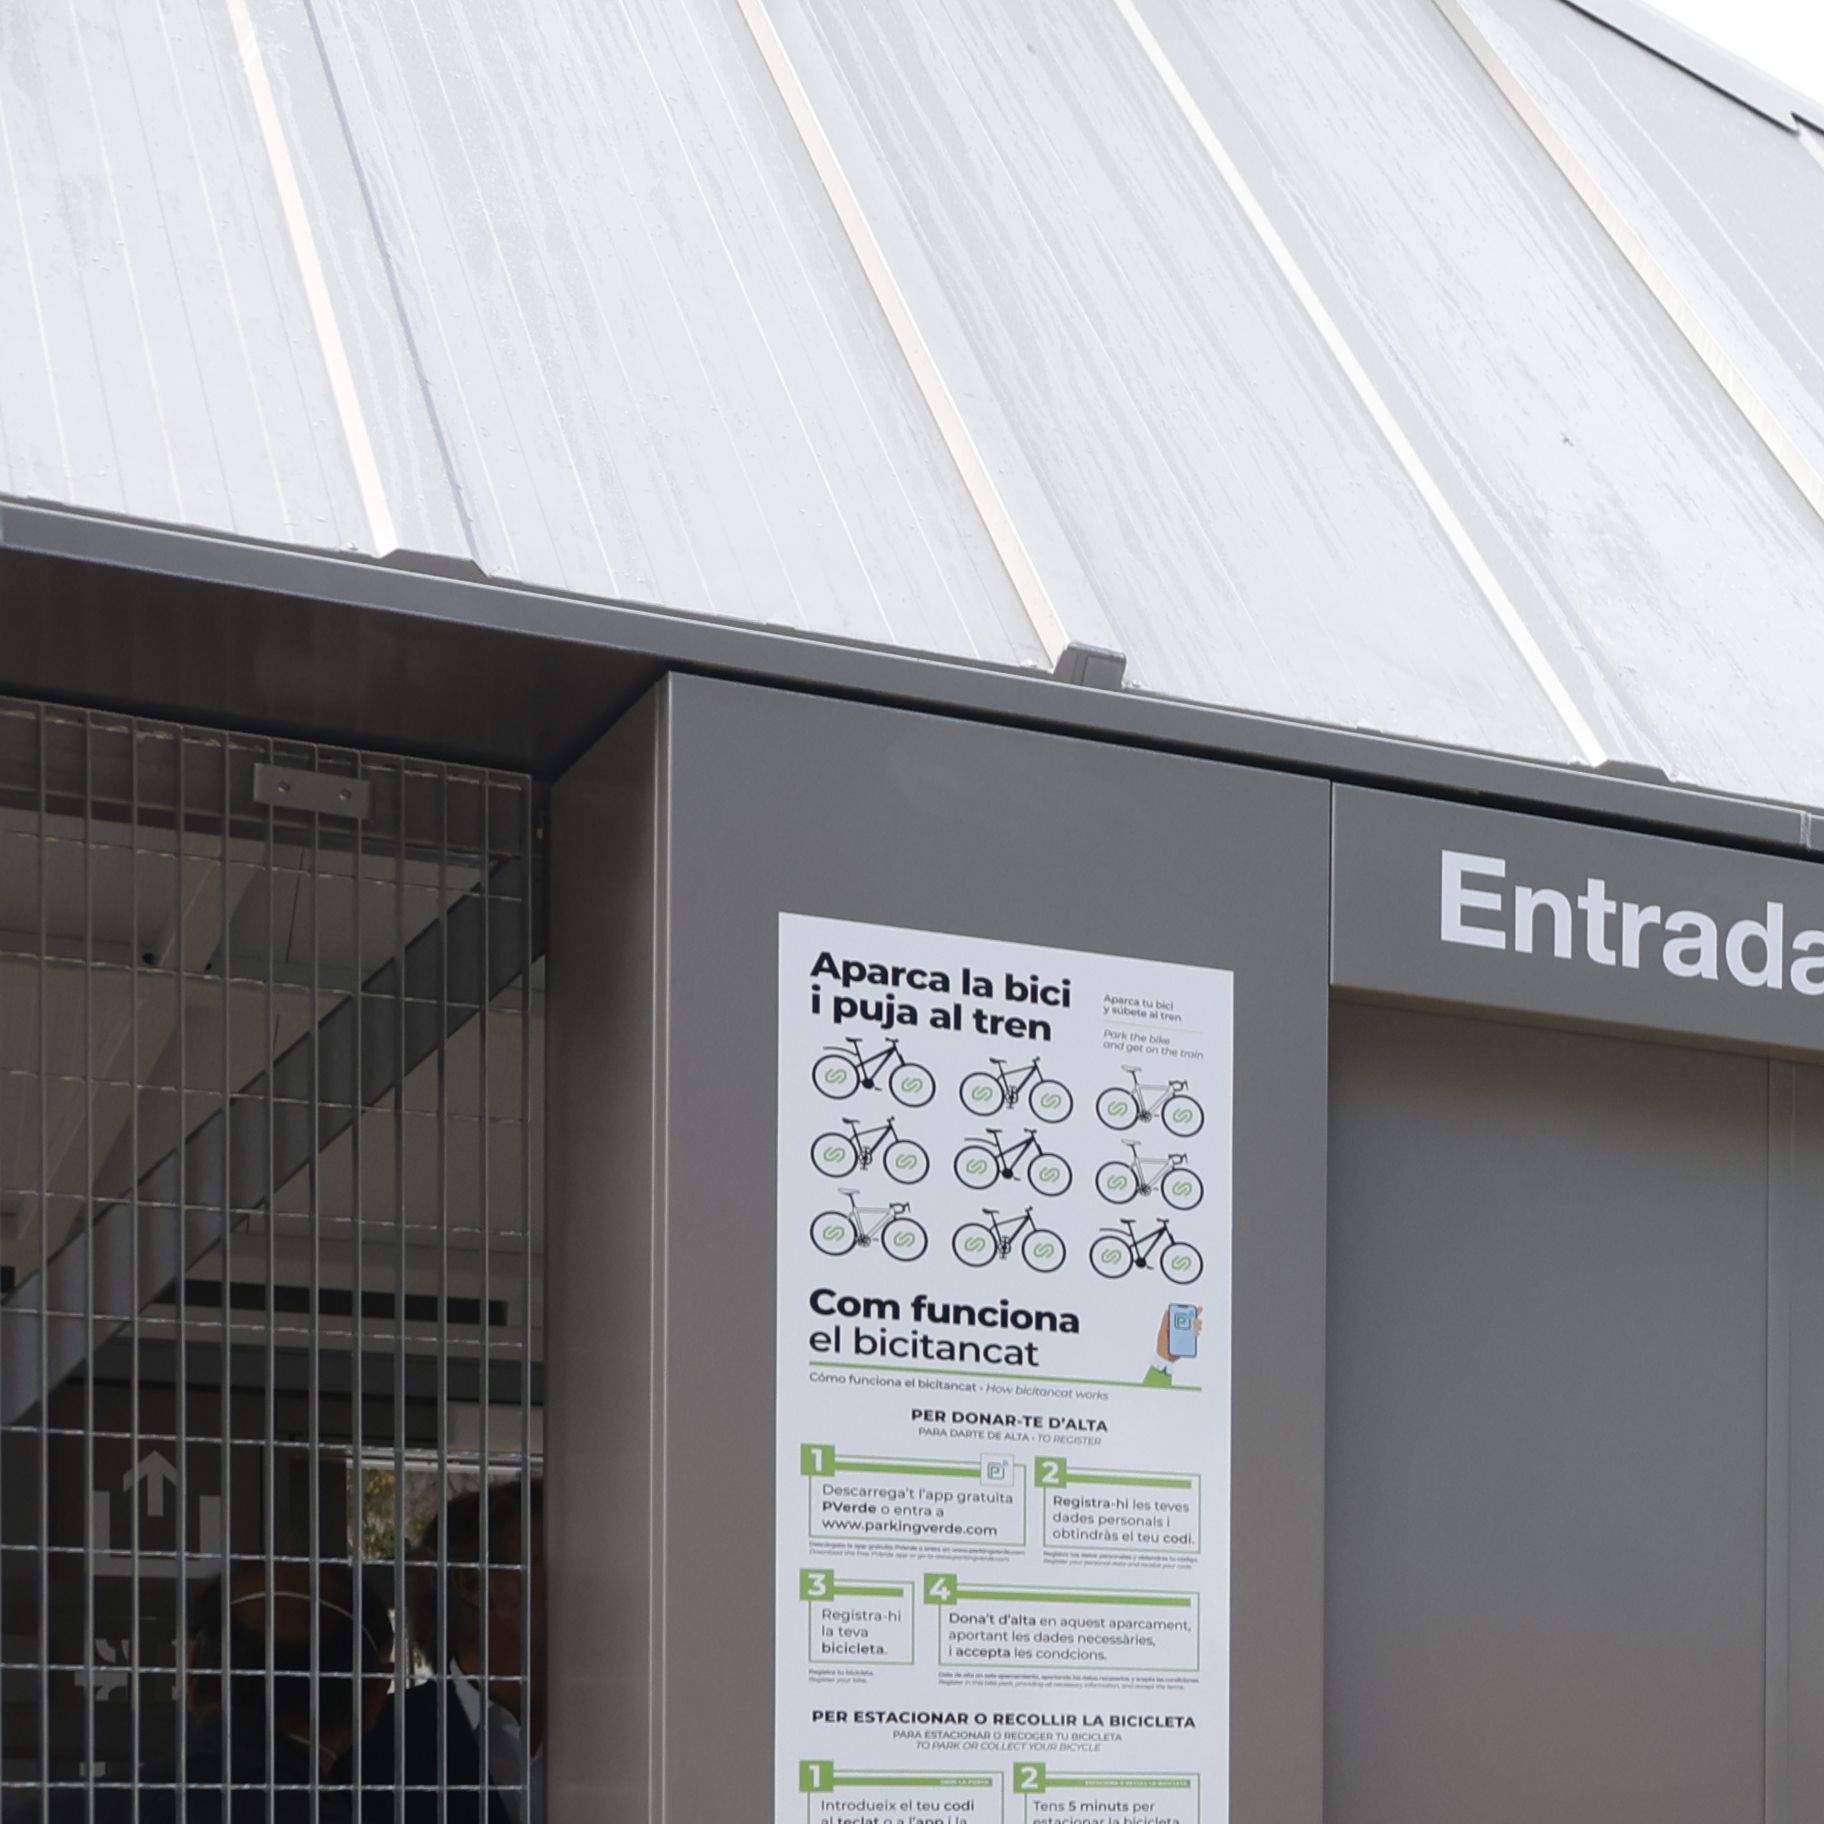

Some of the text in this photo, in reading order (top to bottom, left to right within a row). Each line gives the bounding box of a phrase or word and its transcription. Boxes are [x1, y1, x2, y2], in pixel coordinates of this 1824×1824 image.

[809, 951, 1071, 1008] Aparca la bici
[811, 983, 1051, 1041] i puja al tren
[809, 1288, 1079, 1333] Com funciona
[809, 1324, 1039, 1367] el bicitancat
[911, 1409, 1107, 1431] PER DONAR-TE D'ALTA
[811, 1448, 822, 1471] 1
[1042, 1461, 1059, 1483] 2
[822, 1483, 914, 1500] Descarrega't
[919, 1488, 953, 1503] l'app
[822, 1500, 876, 1513] PVerde
[893, 1506, 931, 1516] entra
[1053, 1495, 1189, 1512] Registra-hi les teves
[822, 1519, 997, 1535] www.parkingverde.com
[1052, 1511, 1163, 1526] dades personals
[1052, 1527, 1118, 1541] obtindràs
[1122, 1531, 1133, 1541] el
[1137, 1532, 1159, 1543] teu
[807, 1573, 825, 1596] 3
[929, 1578, 950, 1600] 4
[822, 1608, 901, 1623] Registra-hi
[949, 1612, 994, 1625] Dona't
[998, 1613, 1036, 1626] d'alta
[1039, 1618, 1056, 1626] en
[1060, 1618, 1105, 1629] aquest
[821, 1624, 868, 1637] la teva
[948, 1630, 1007, 1642] aportant
[1012, 1630, 1030, 1642] les
[1033, 1631, 1074, 1643] dades
[955, 1647, 1010, 1660] accepta
[1014, 1647, 1032, 1658] les
[812, 1710, 847, 1722] PER
[854, 1711, 968, 1724] ESTACIONAR
[993, 1713, 1076, 1725] RECOLLIR
[1082, 1715, 1103, 1726] LA
[1109, 1715, 1195, 1727] BICICLETA
[809, 1765, 820, 1787] 1
[1021, 1766, 1038, 1788] 2
[821, 1799, 974, 1811] Introdueix el teu codi
[1033, 1800, 1064, 1811] Tens
[1080, 1801, 1129, 1812] minuts
[1132, 1803, 1153, 1813] per
